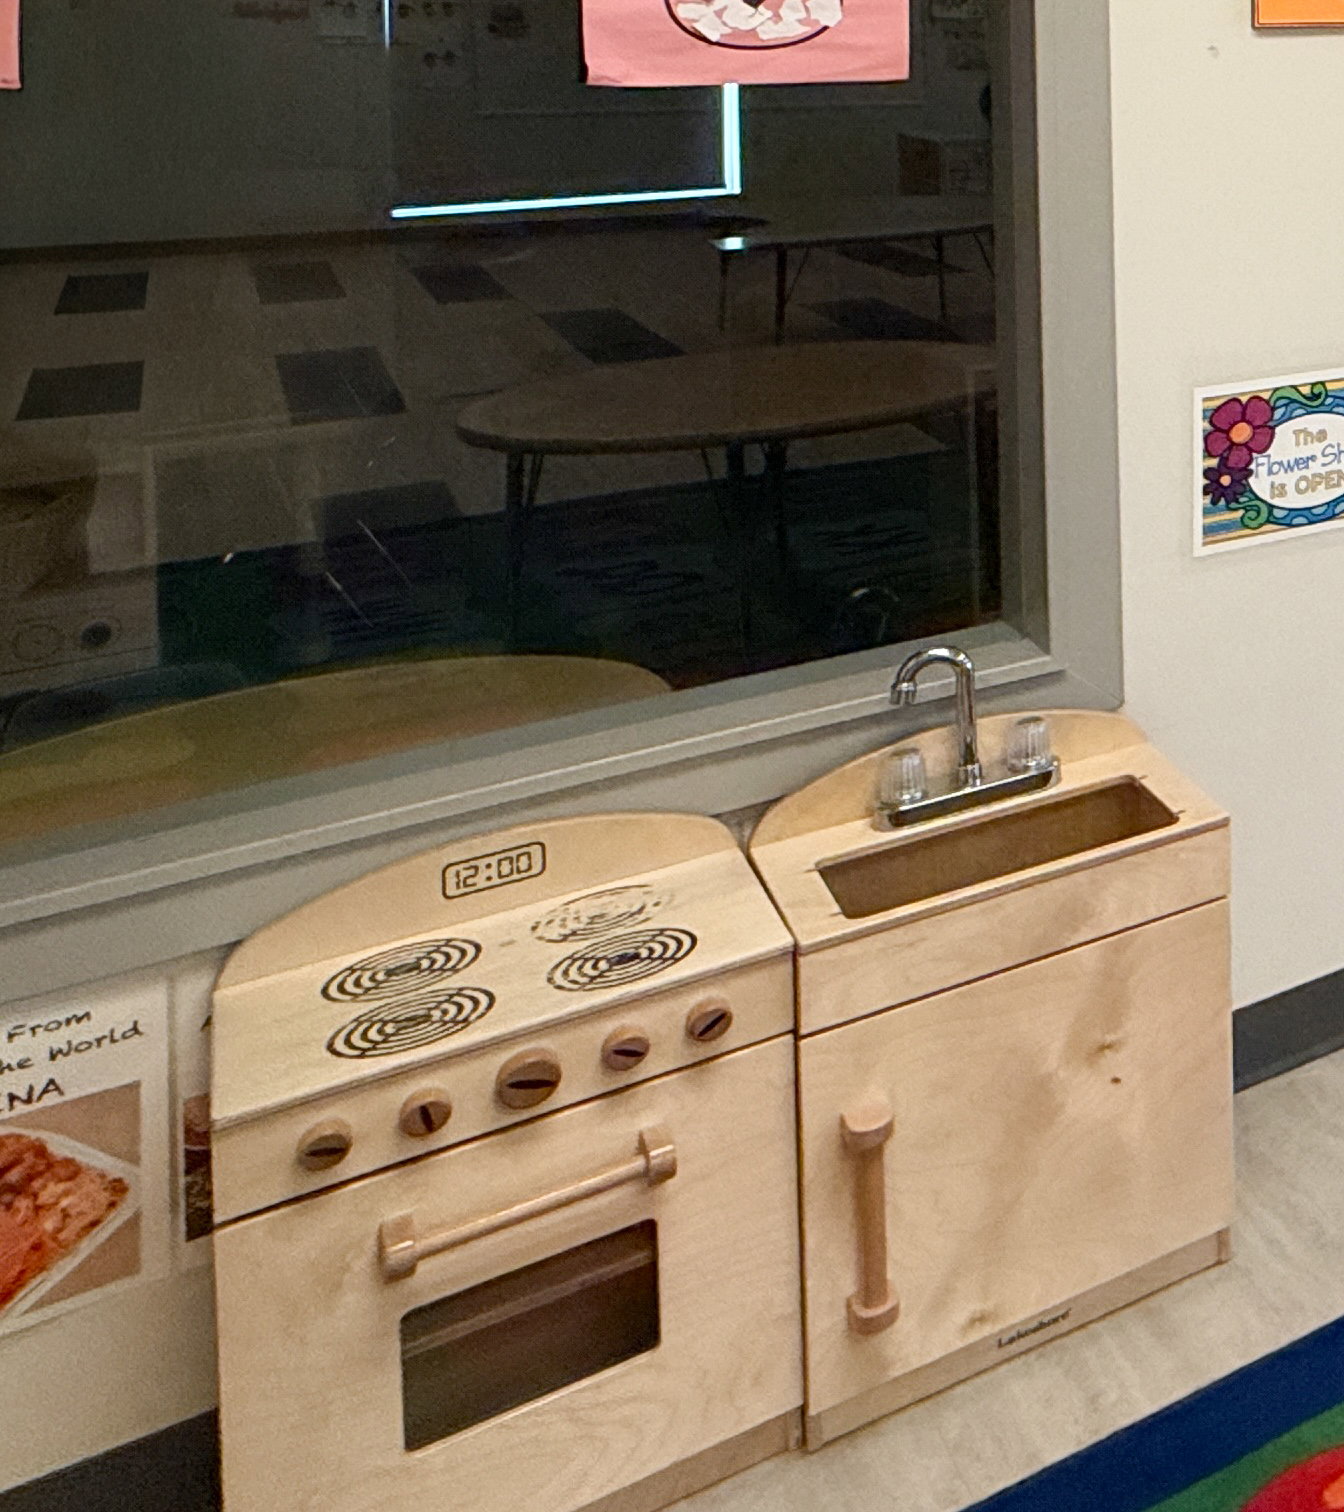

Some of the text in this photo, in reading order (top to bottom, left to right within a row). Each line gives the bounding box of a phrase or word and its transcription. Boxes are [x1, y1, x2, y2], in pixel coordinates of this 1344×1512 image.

[1292, 428, 1328, 447] The
[1254, 454, 1318, 479] Flower
[455, 851, 533, 890] 12:00
[7, 1011, 92, 1043] From
[49, 1020, 145, 1062] World
[0, 1077, 65, 1112] NA
